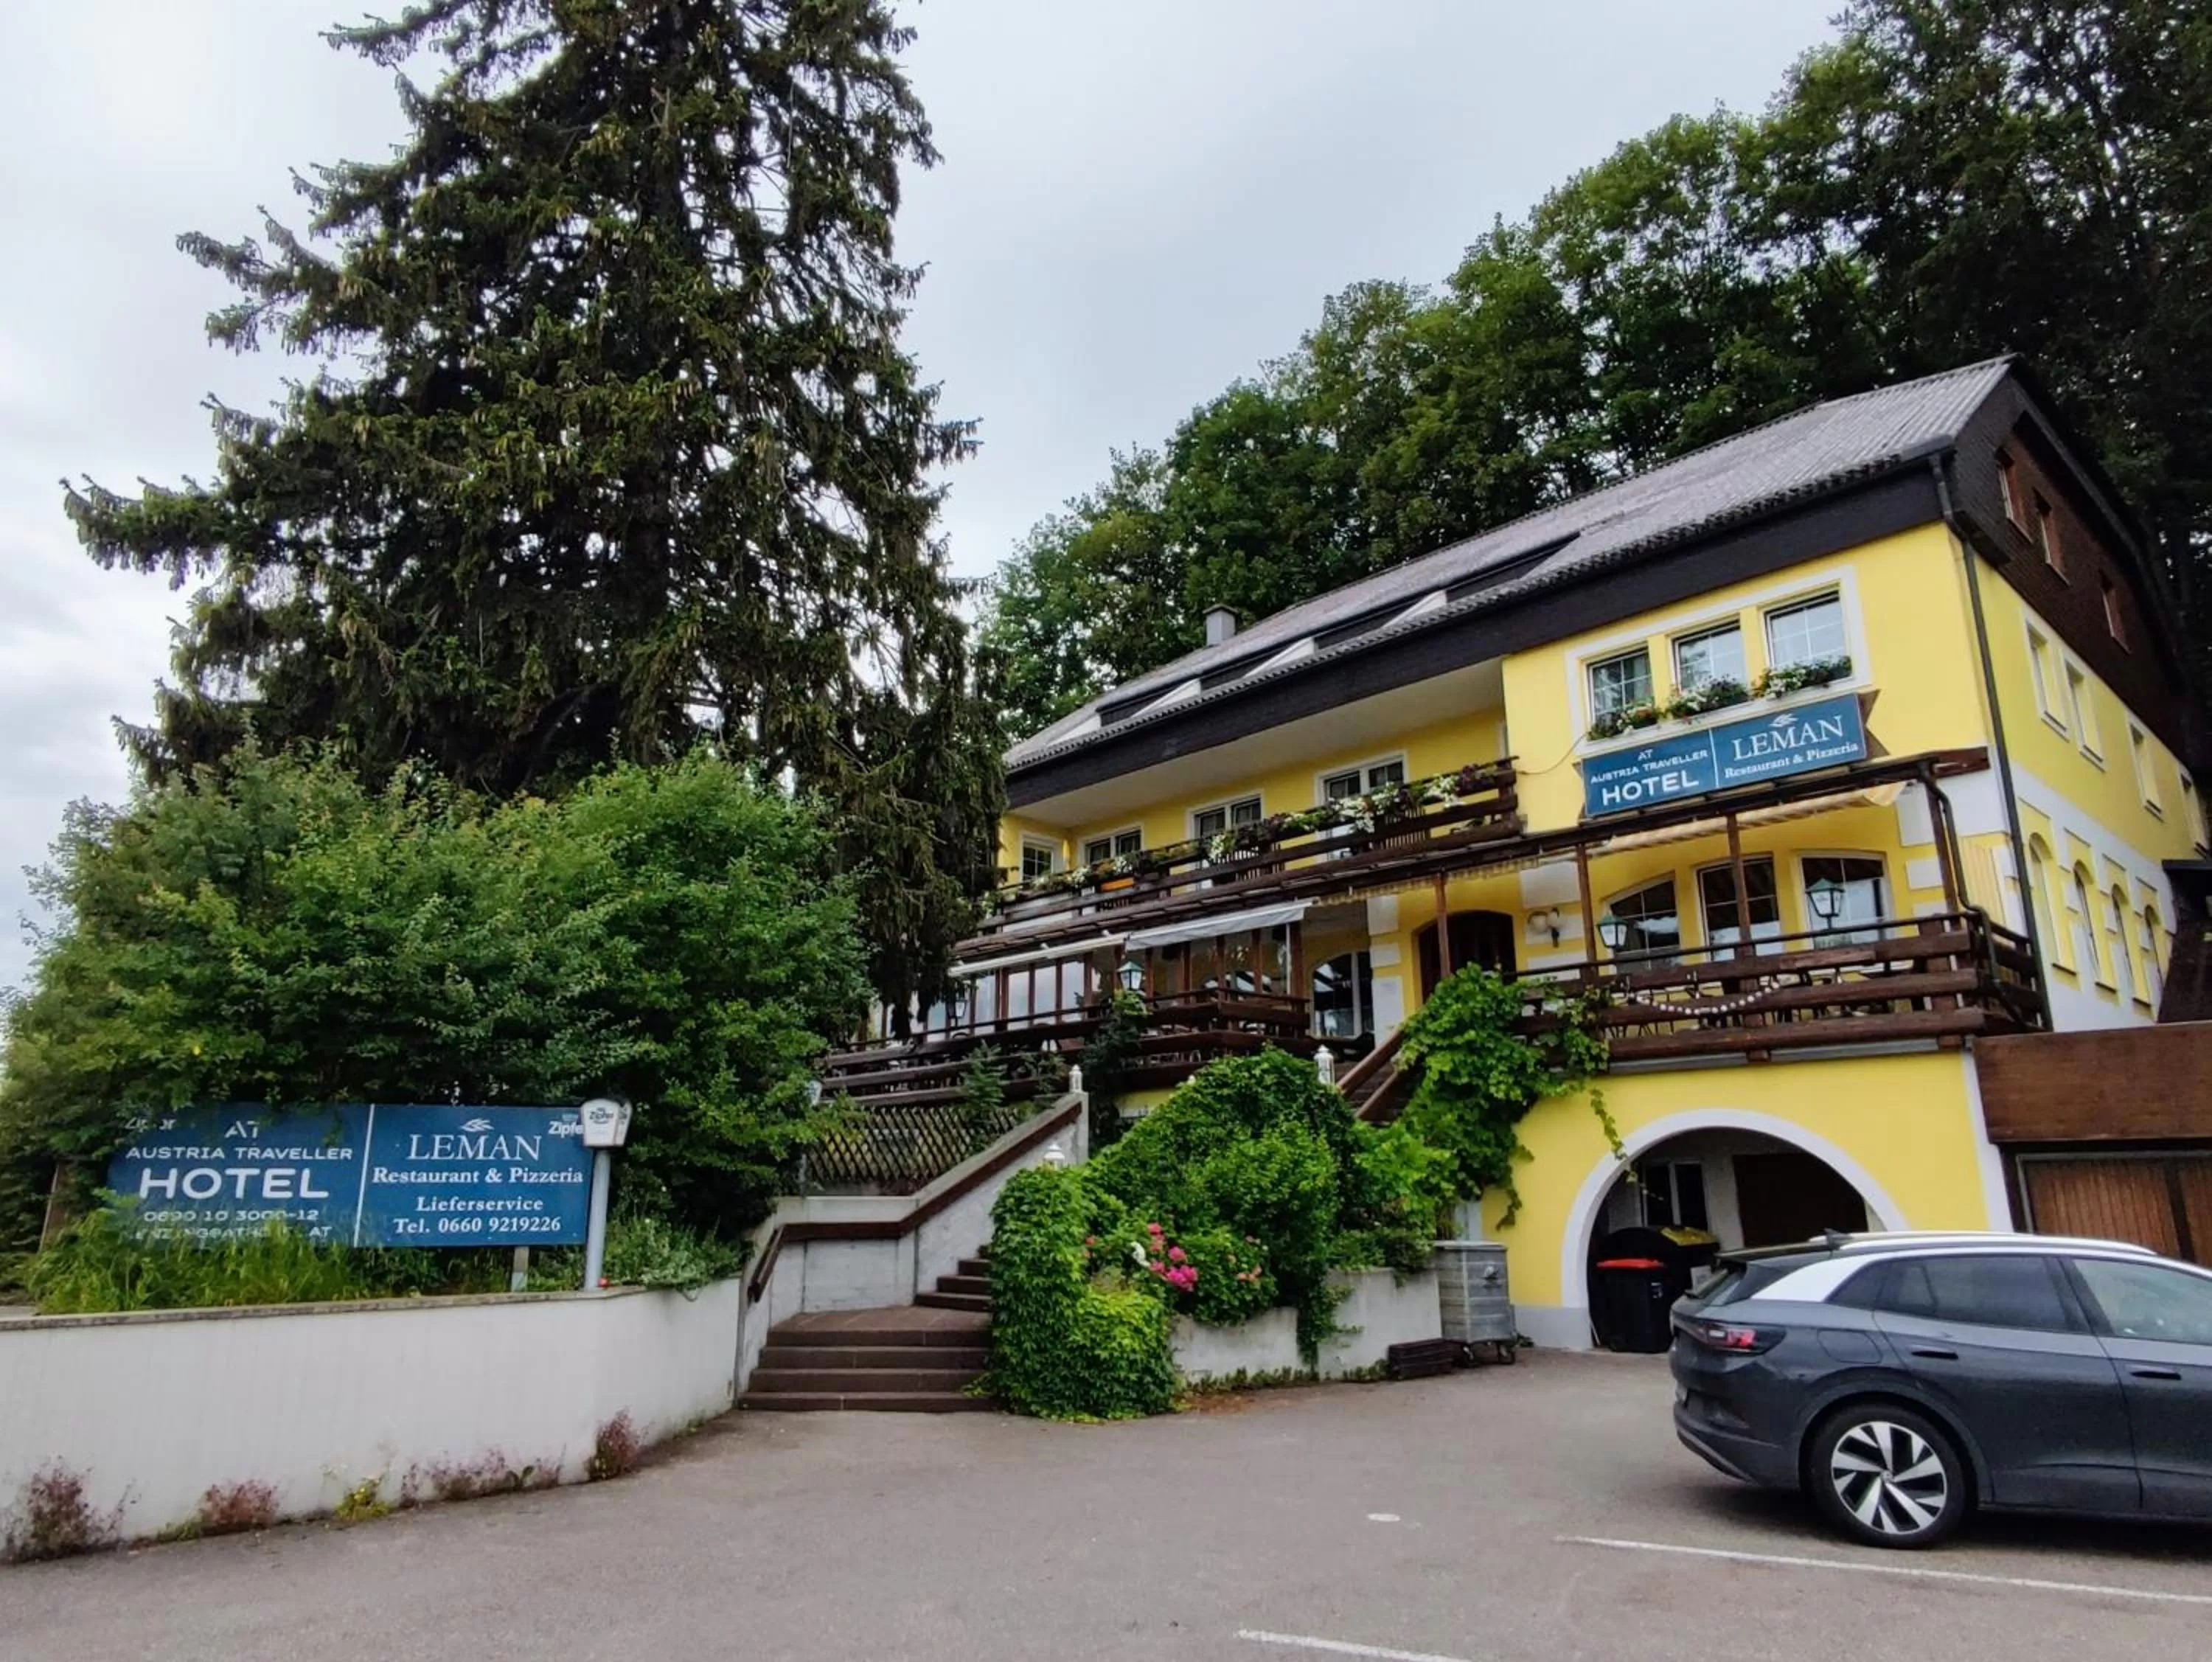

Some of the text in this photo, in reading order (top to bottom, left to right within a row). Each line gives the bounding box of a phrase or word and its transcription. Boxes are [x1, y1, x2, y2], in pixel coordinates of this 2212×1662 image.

[1733, 714, 1843, 760] LEMAN
[1637, 748, 1654, 762] AT
[1724, 741, 1860, 779] Restaurant & Pizzeria
[1590, 749, 1708, 785] AUSTRIA TRAVELLER
[1601, 771, 1700, 806] HOTEL
[548, 1121, 585, 1138] Zipfe
[125, 1147, 353, 1160] AUSTRIA TRAVELLER
[406, 1134, 542, 1161] LEMAN
[139, 1167, 330, 1199] HOTEL
[372, 1166, 583, 1183] Restaurant & Pizzeria
[415, 1196, 543, 1212] Lieferservice
[204, 1210, 229, 1221] 10
[393, 1216, 561, 1234] Tel. 0660 9219226
